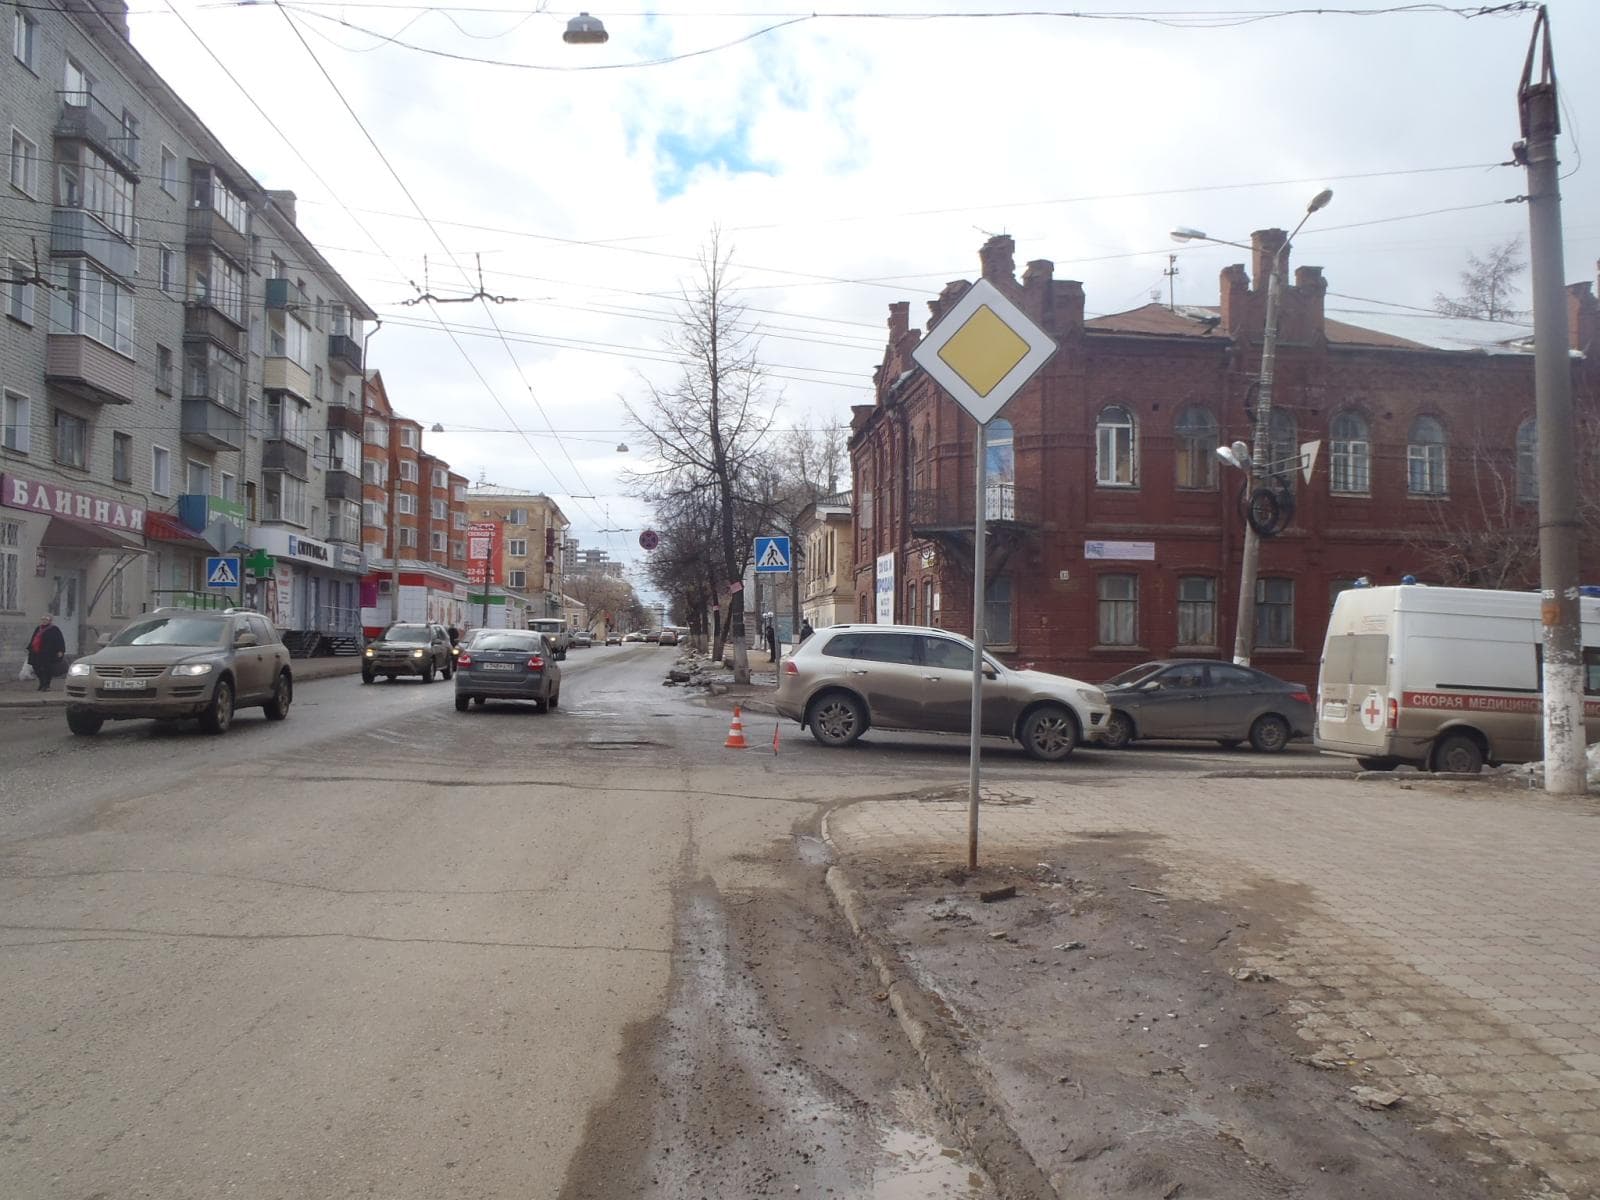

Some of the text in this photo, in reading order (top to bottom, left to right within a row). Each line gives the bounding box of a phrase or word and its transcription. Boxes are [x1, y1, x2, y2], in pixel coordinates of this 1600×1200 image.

[12, 479, 143, 530] БЛИННАЯ
[298, 540, 328, 561] ОПТИКА
[1412, 694, 1540, 712] СКОРАЯ МЕДИЦИНС
